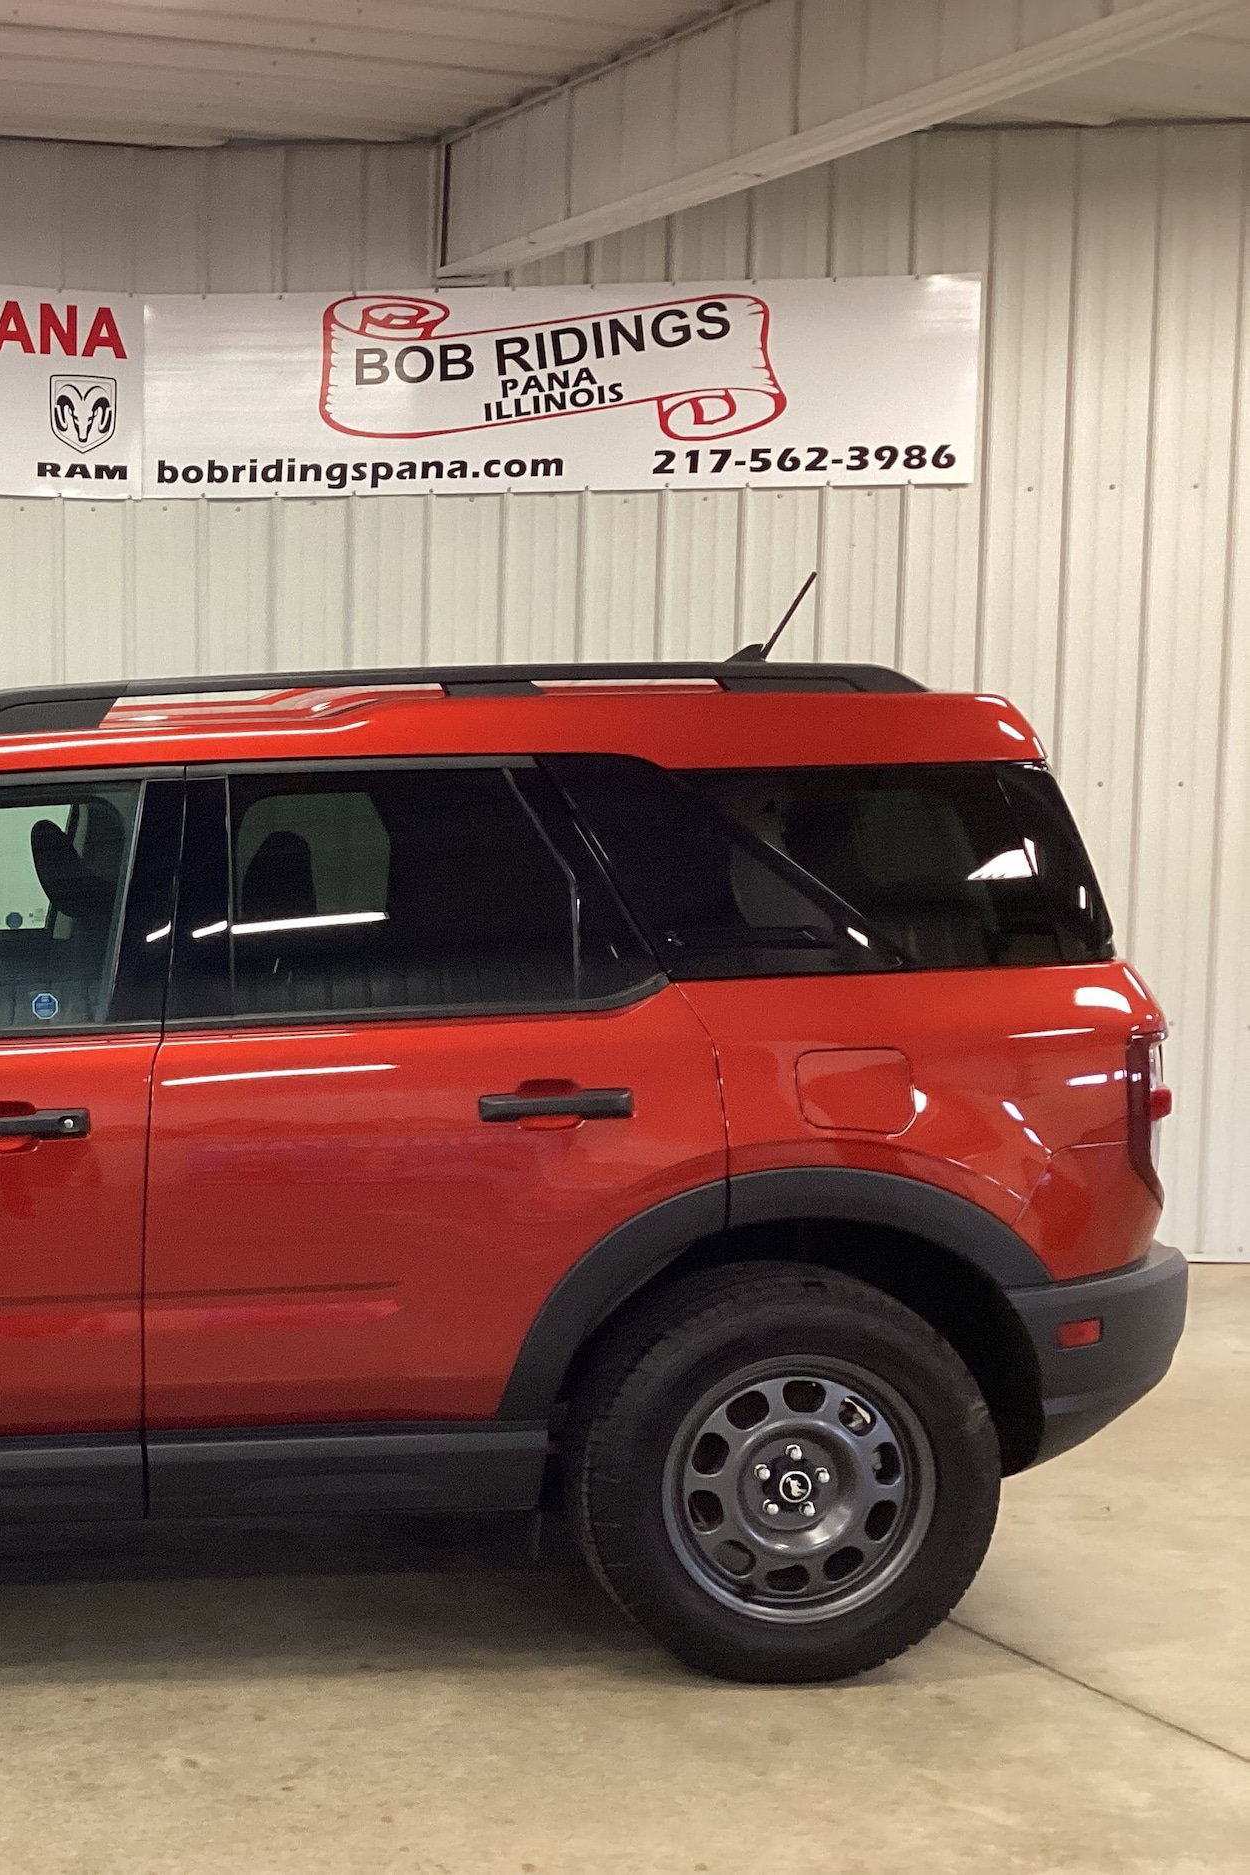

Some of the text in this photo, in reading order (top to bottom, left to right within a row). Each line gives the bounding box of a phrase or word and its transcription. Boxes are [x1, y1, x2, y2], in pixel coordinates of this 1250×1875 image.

[355, 301, 731, 386] BOB RIDINGS
[500, 366, 598, 398] PANA
[484, 382, 624, 422] ILLINOIS
[37, 461, 128, 480] RAM
[157, 457, 565, 489] bobridingspana.com
[652, 444, 957, 475] 217-562-3986
